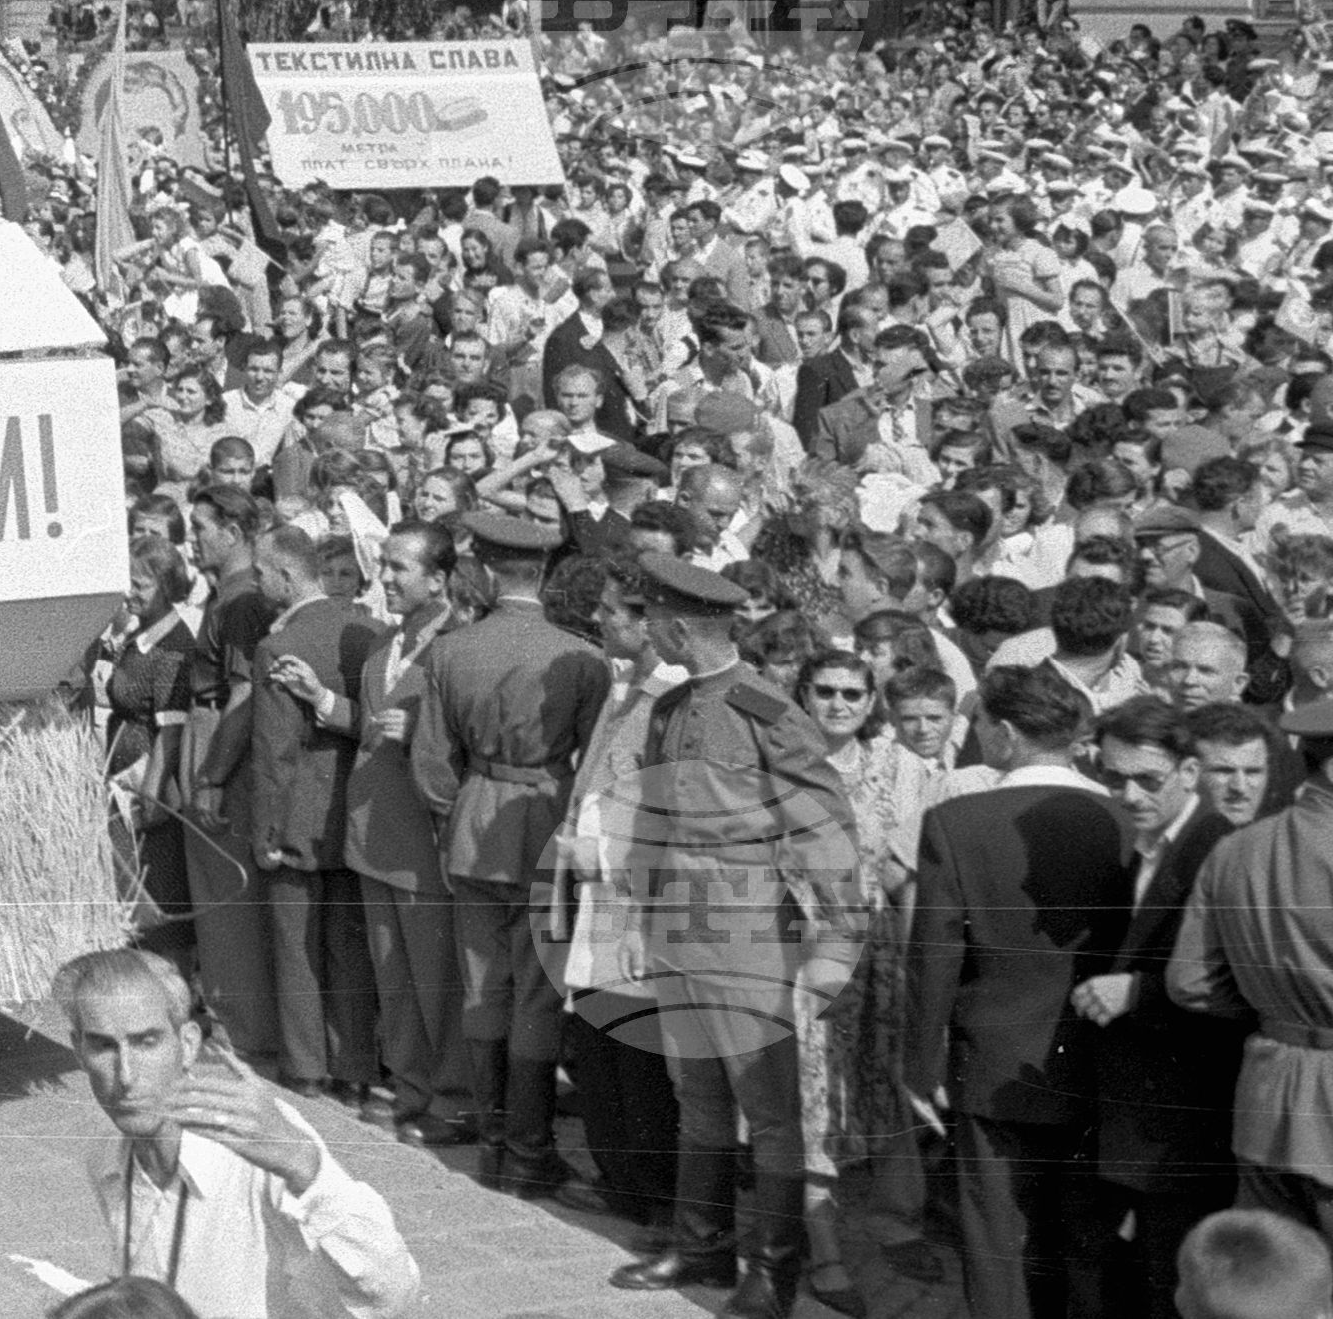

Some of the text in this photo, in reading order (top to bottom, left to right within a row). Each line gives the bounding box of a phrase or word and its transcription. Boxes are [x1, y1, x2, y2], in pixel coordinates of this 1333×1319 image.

[255, 49, 519, 72] ТЕКСТИЛНА СЛАВА
[341, 143, 399, 154] МЕТРА
[365, 158, 429, 171] СВЪРХ
